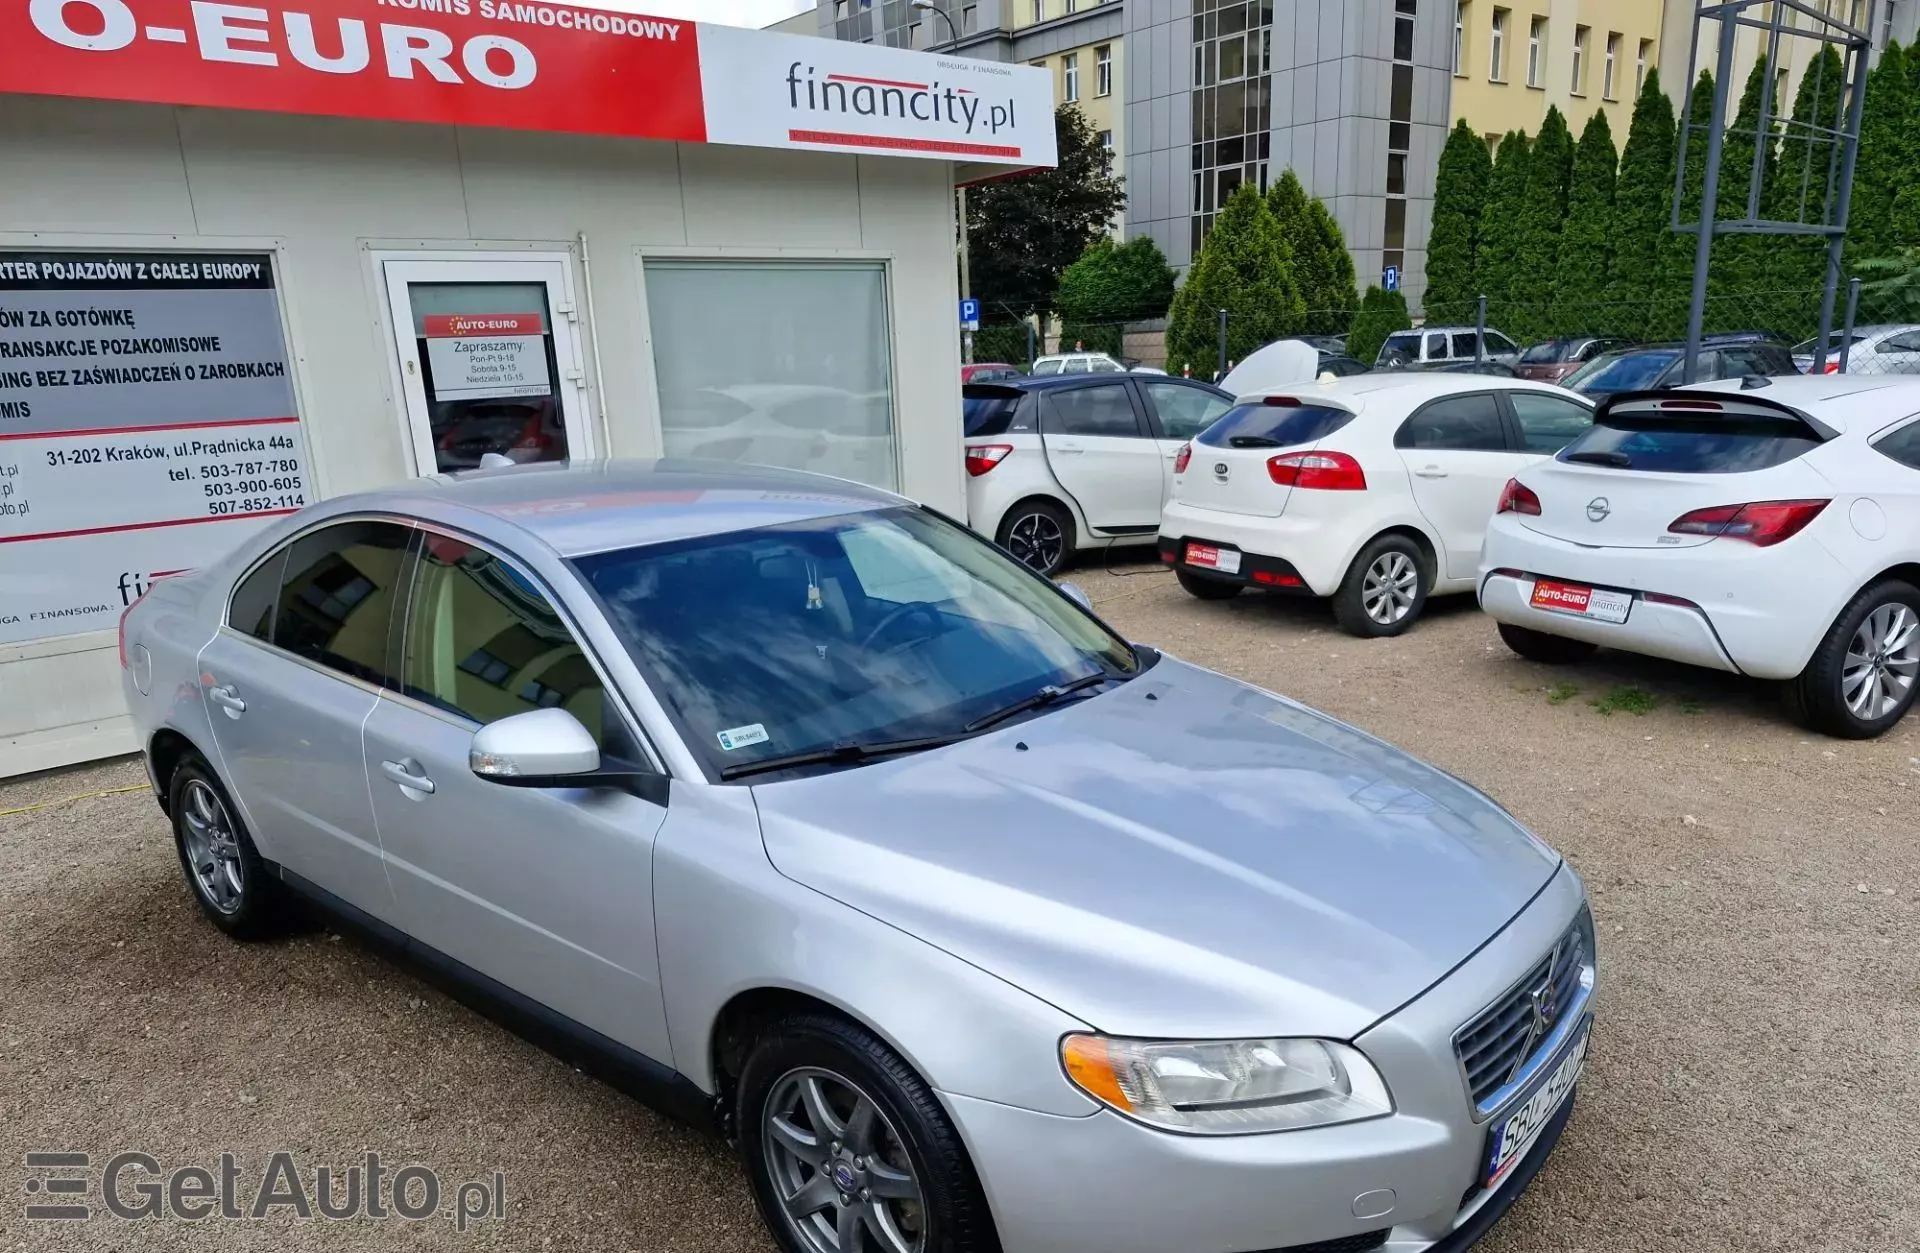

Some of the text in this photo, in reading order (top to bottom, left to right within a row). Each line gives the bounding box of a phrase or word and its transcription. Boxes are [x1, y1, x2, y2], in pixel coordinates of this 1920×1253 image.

[480, 1, 680, 42] SAMOCHODOWY
[936, 60, 1012, 77] OBSŁUGA FINANSOWA
[786, 61, 1016, 134] financity.pl
[43, 259, 132, 280] POJAZDÓW
[136, 263, 148, 280] Z
[150, 263, 199, 280] CAŁEJ
[202, 263, 261, 280] EUROPY
[1387, 269, 1395, 289] P
[28, 310, 52, 328] ZA
[56, 306, 136, 330] GOTÓWKĘ
[964, 302, 975, 319] P
[456, 319, 518, 330] AUTO-EURO
[0, 336, 221, 358] RANSAKCJE POZAKOMISOWE
[454, 341, 526, 354] Zapraszamy:
[497, 354, 515, 362] 9-18
[36, 370, 69, 387] BEZ
[72, 361, 181, 386] ZAŚWIADCZEŃ
[185, 365, 196, 380] O
[199, 361, 285, 380] ZAROBKACH
[466, 373, 524, 384] Niedziela 10-15
[471, 364, 517, 374] Sobota 9-15
[0, 401, 31, 419] MIS
[47, 436, 294, 467] 31-202 Kraków, ul.Prądnicka 44a
[169, 459, 298, 482] tel. 503-787-780
[204, 476, 302, 497] 503-900-605
[209, 494, 305, 515] 507-852-114
[117, 572, 152, 607] fi
[1539, 588, 1587, 605] AUTO-EURO
[0, 604, 116, 625] GA FINANSOWA:
